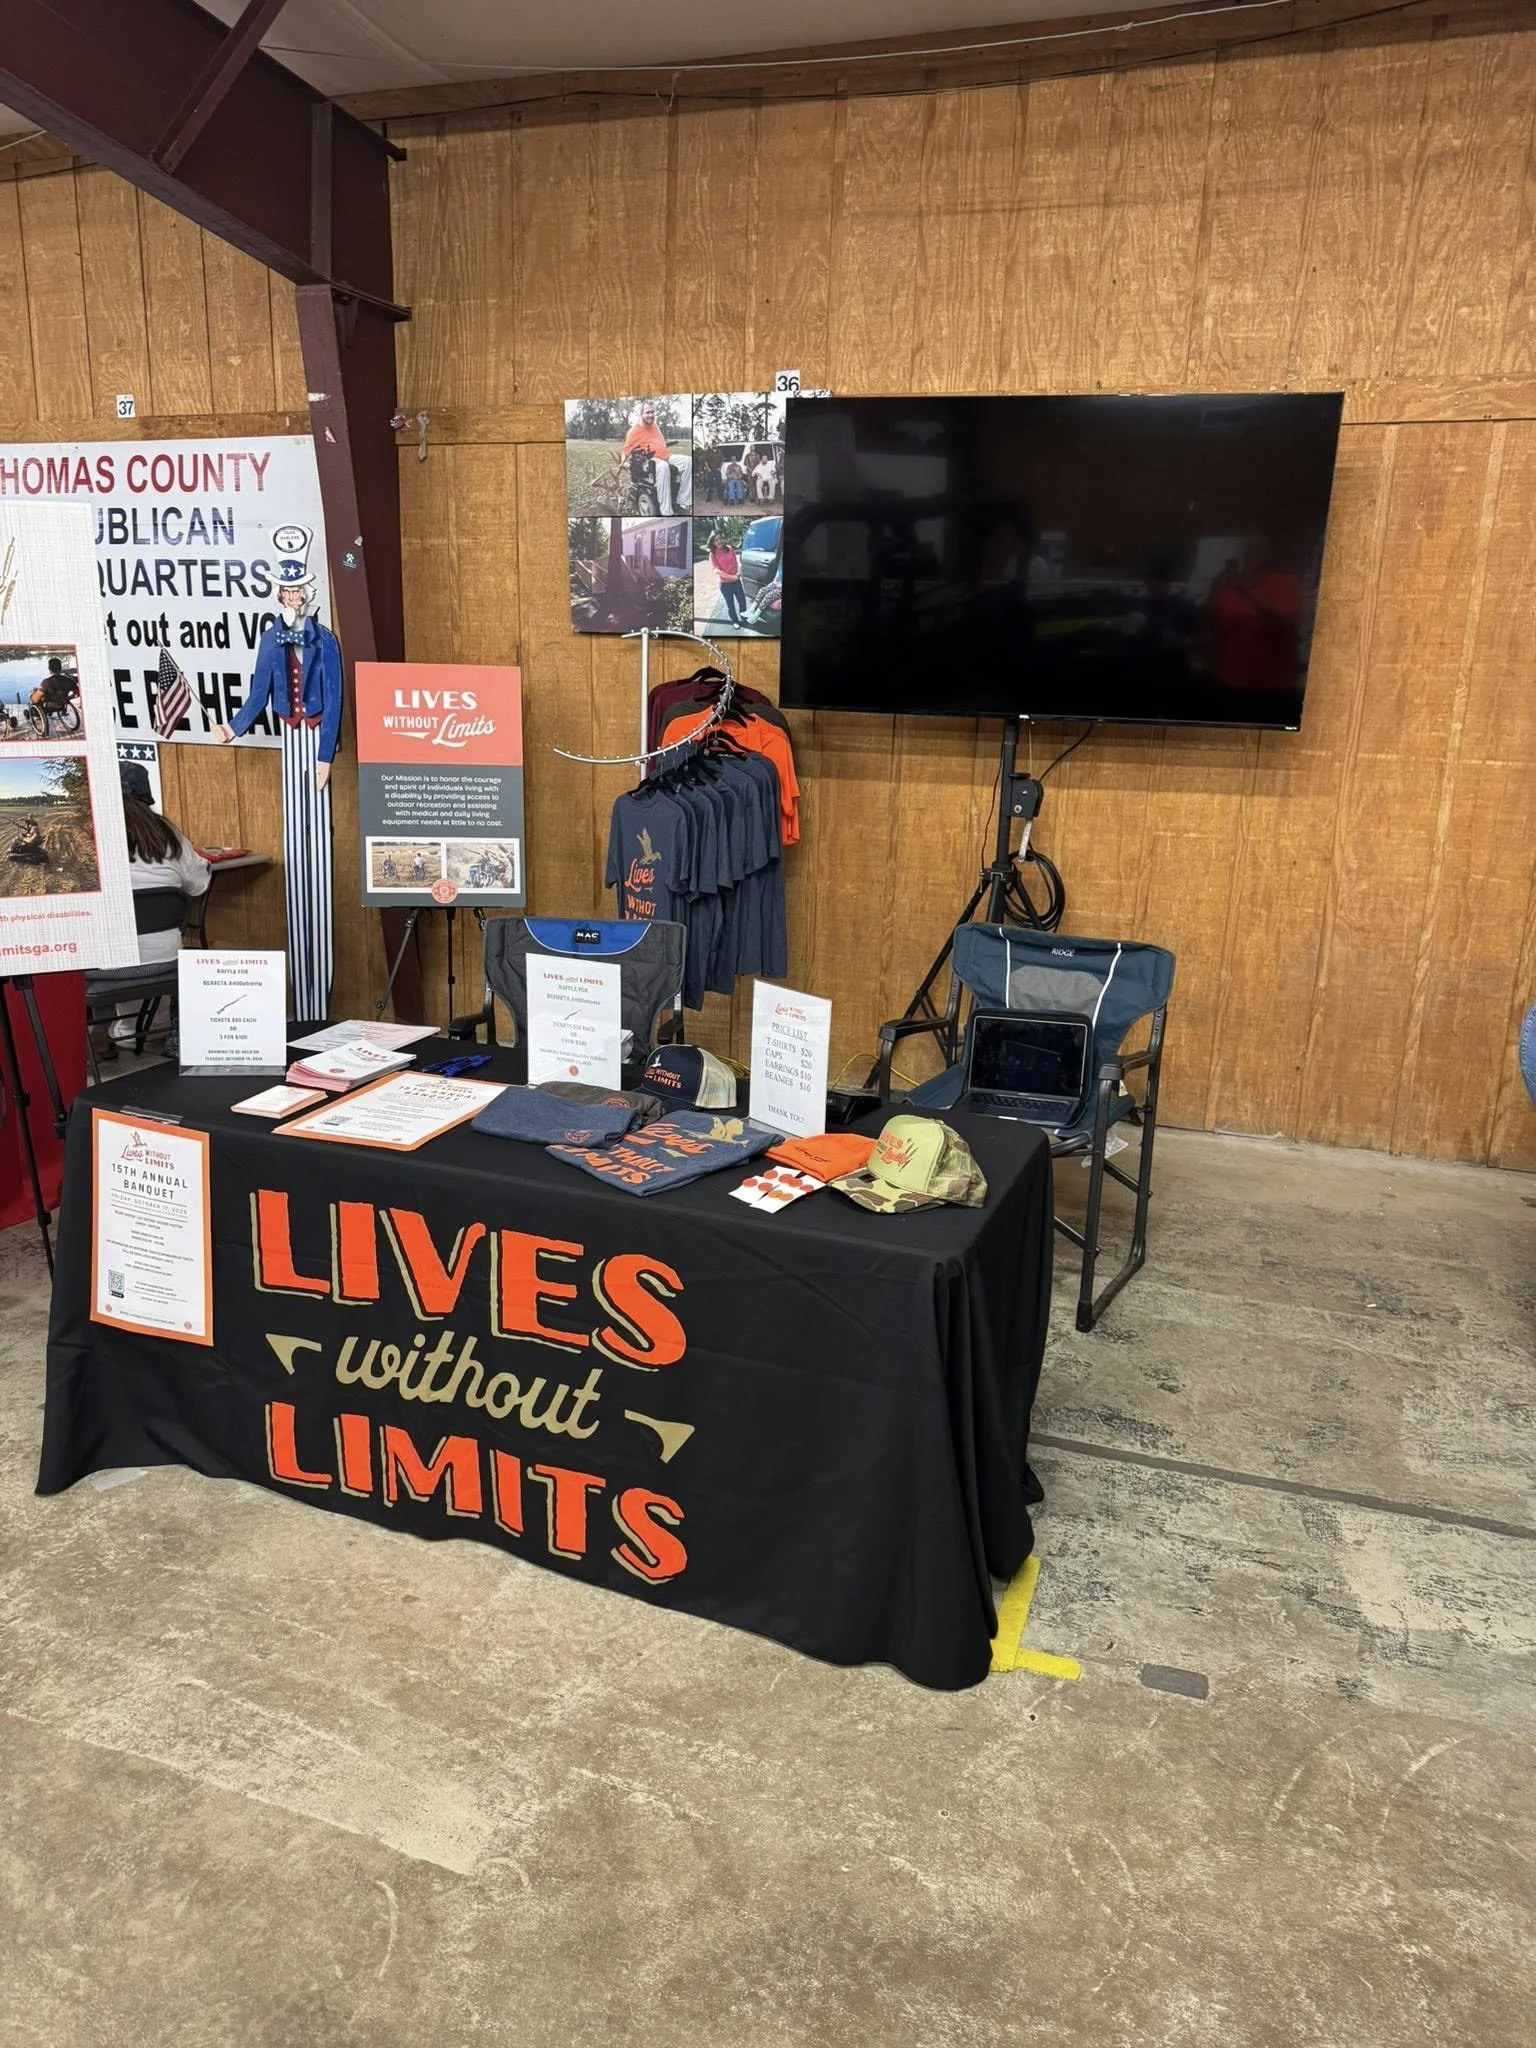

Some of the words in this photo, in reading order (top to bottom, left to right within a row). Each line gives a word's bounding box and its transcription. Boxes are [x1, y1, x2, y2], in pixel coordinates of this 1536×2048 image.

[777, 376, 799, 391] 36
[118, 401, 134, 416] 37
[127, 453, 271, 493] COUNTY
[126, 611, 171, 648] out
[179, 612, 231, 649] and
[395, 689, 478, 711] LIVES
[383, 715, 440, 729] WITHOUT
[431, 712, 497, 748] Limits
[391, 792, 421, 800] disability
[465, 785, 483, 793] living
[467, 802, 497, 810] assisting
[472, 811, 490, 819] living
[624, 858, 655, 892] Lives
[11, 912, 45, 922] physical
[47, 910, 93, 919] disabilities.
[576, 931, 599, 939] MAC
[0, 942, 77, 956] mitsga.org
[543, 972, 564, 981] LIVES
[579, 977, 603, 986] LIMITS
[772, 1021, 792, 1036] PRICE
[792, 1028, 808, 1041] LIST
[766, 1036, 796, 1053] T-SHIRTS
[800, 1048, 812, 1058] $20
[765, 1047, 783, 1060] CAPS
[800, 1059, 812, 1069] $20
[765, 1059, 799, 1077] EARRINGS
[800, 1070, 812, 1081] $10
[653, 1074, 682, 1089] LIMITS
[764, 1070, 794, 1087] BEANIES
[799, 1082, 811, 1092] $10
[767, 1104, 788, 1119] THANK
[145, 1149, 171, 1161] WITHOUT
[145, 1158, 175, 1170] LIMITS
[112, 1163, 137, 1176] 15TH
[142, 1170, 188, 1189] ANNUAL
[123, 1179, 174, 1199] BANQUET
[250, 1188, 687, 1371] LIVES
[336, 1330, 604, 1440] without
[265, 1401, 687, 1585] LIMITS
